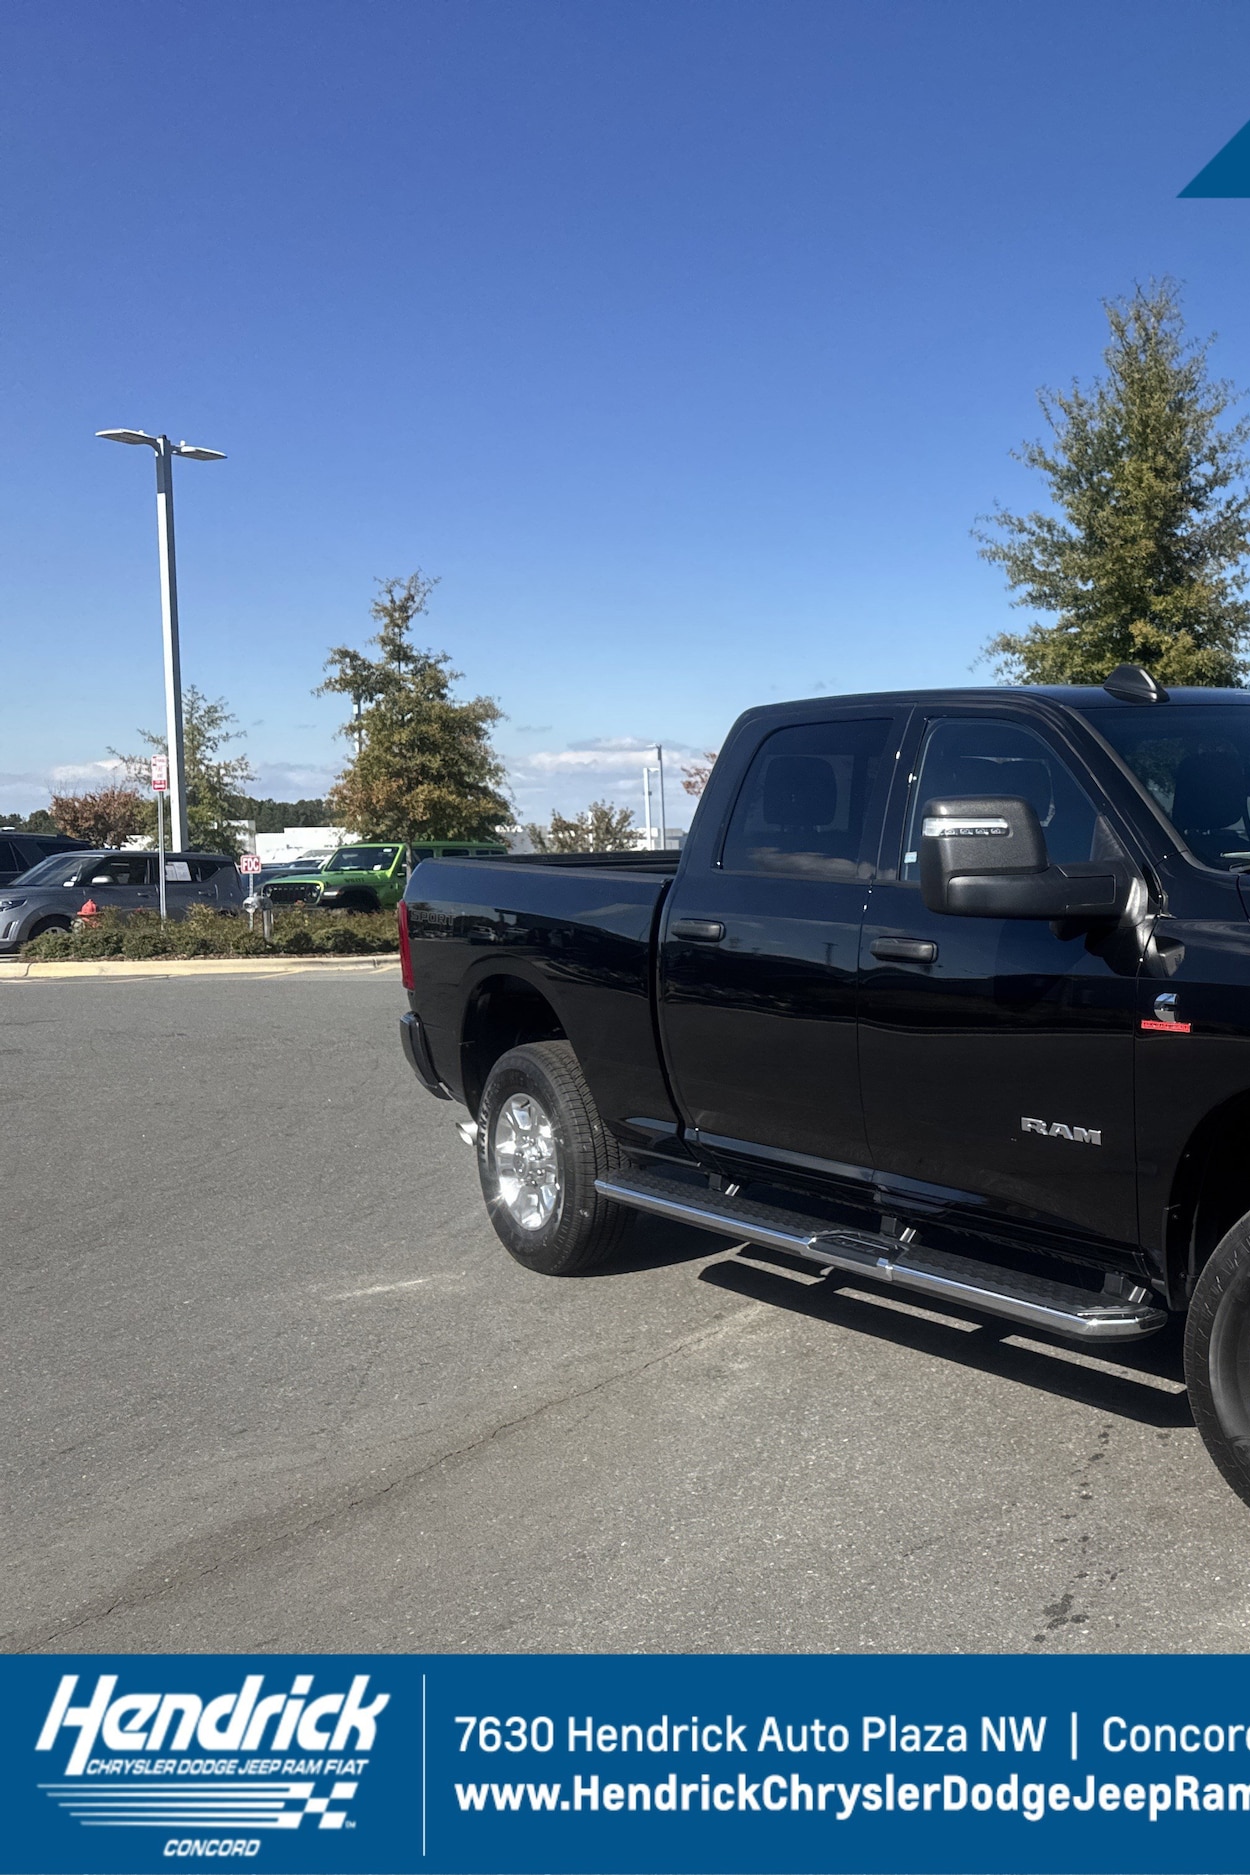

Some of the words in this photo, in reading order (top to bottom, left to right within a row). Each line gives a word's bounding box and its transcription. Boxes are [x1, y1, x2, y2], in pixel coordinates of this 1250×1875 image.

[242, 857, 259, 871] FDC
[410, 909, 457, 926] SPORT
[1021, 1116, 1102, 1147] RAM
